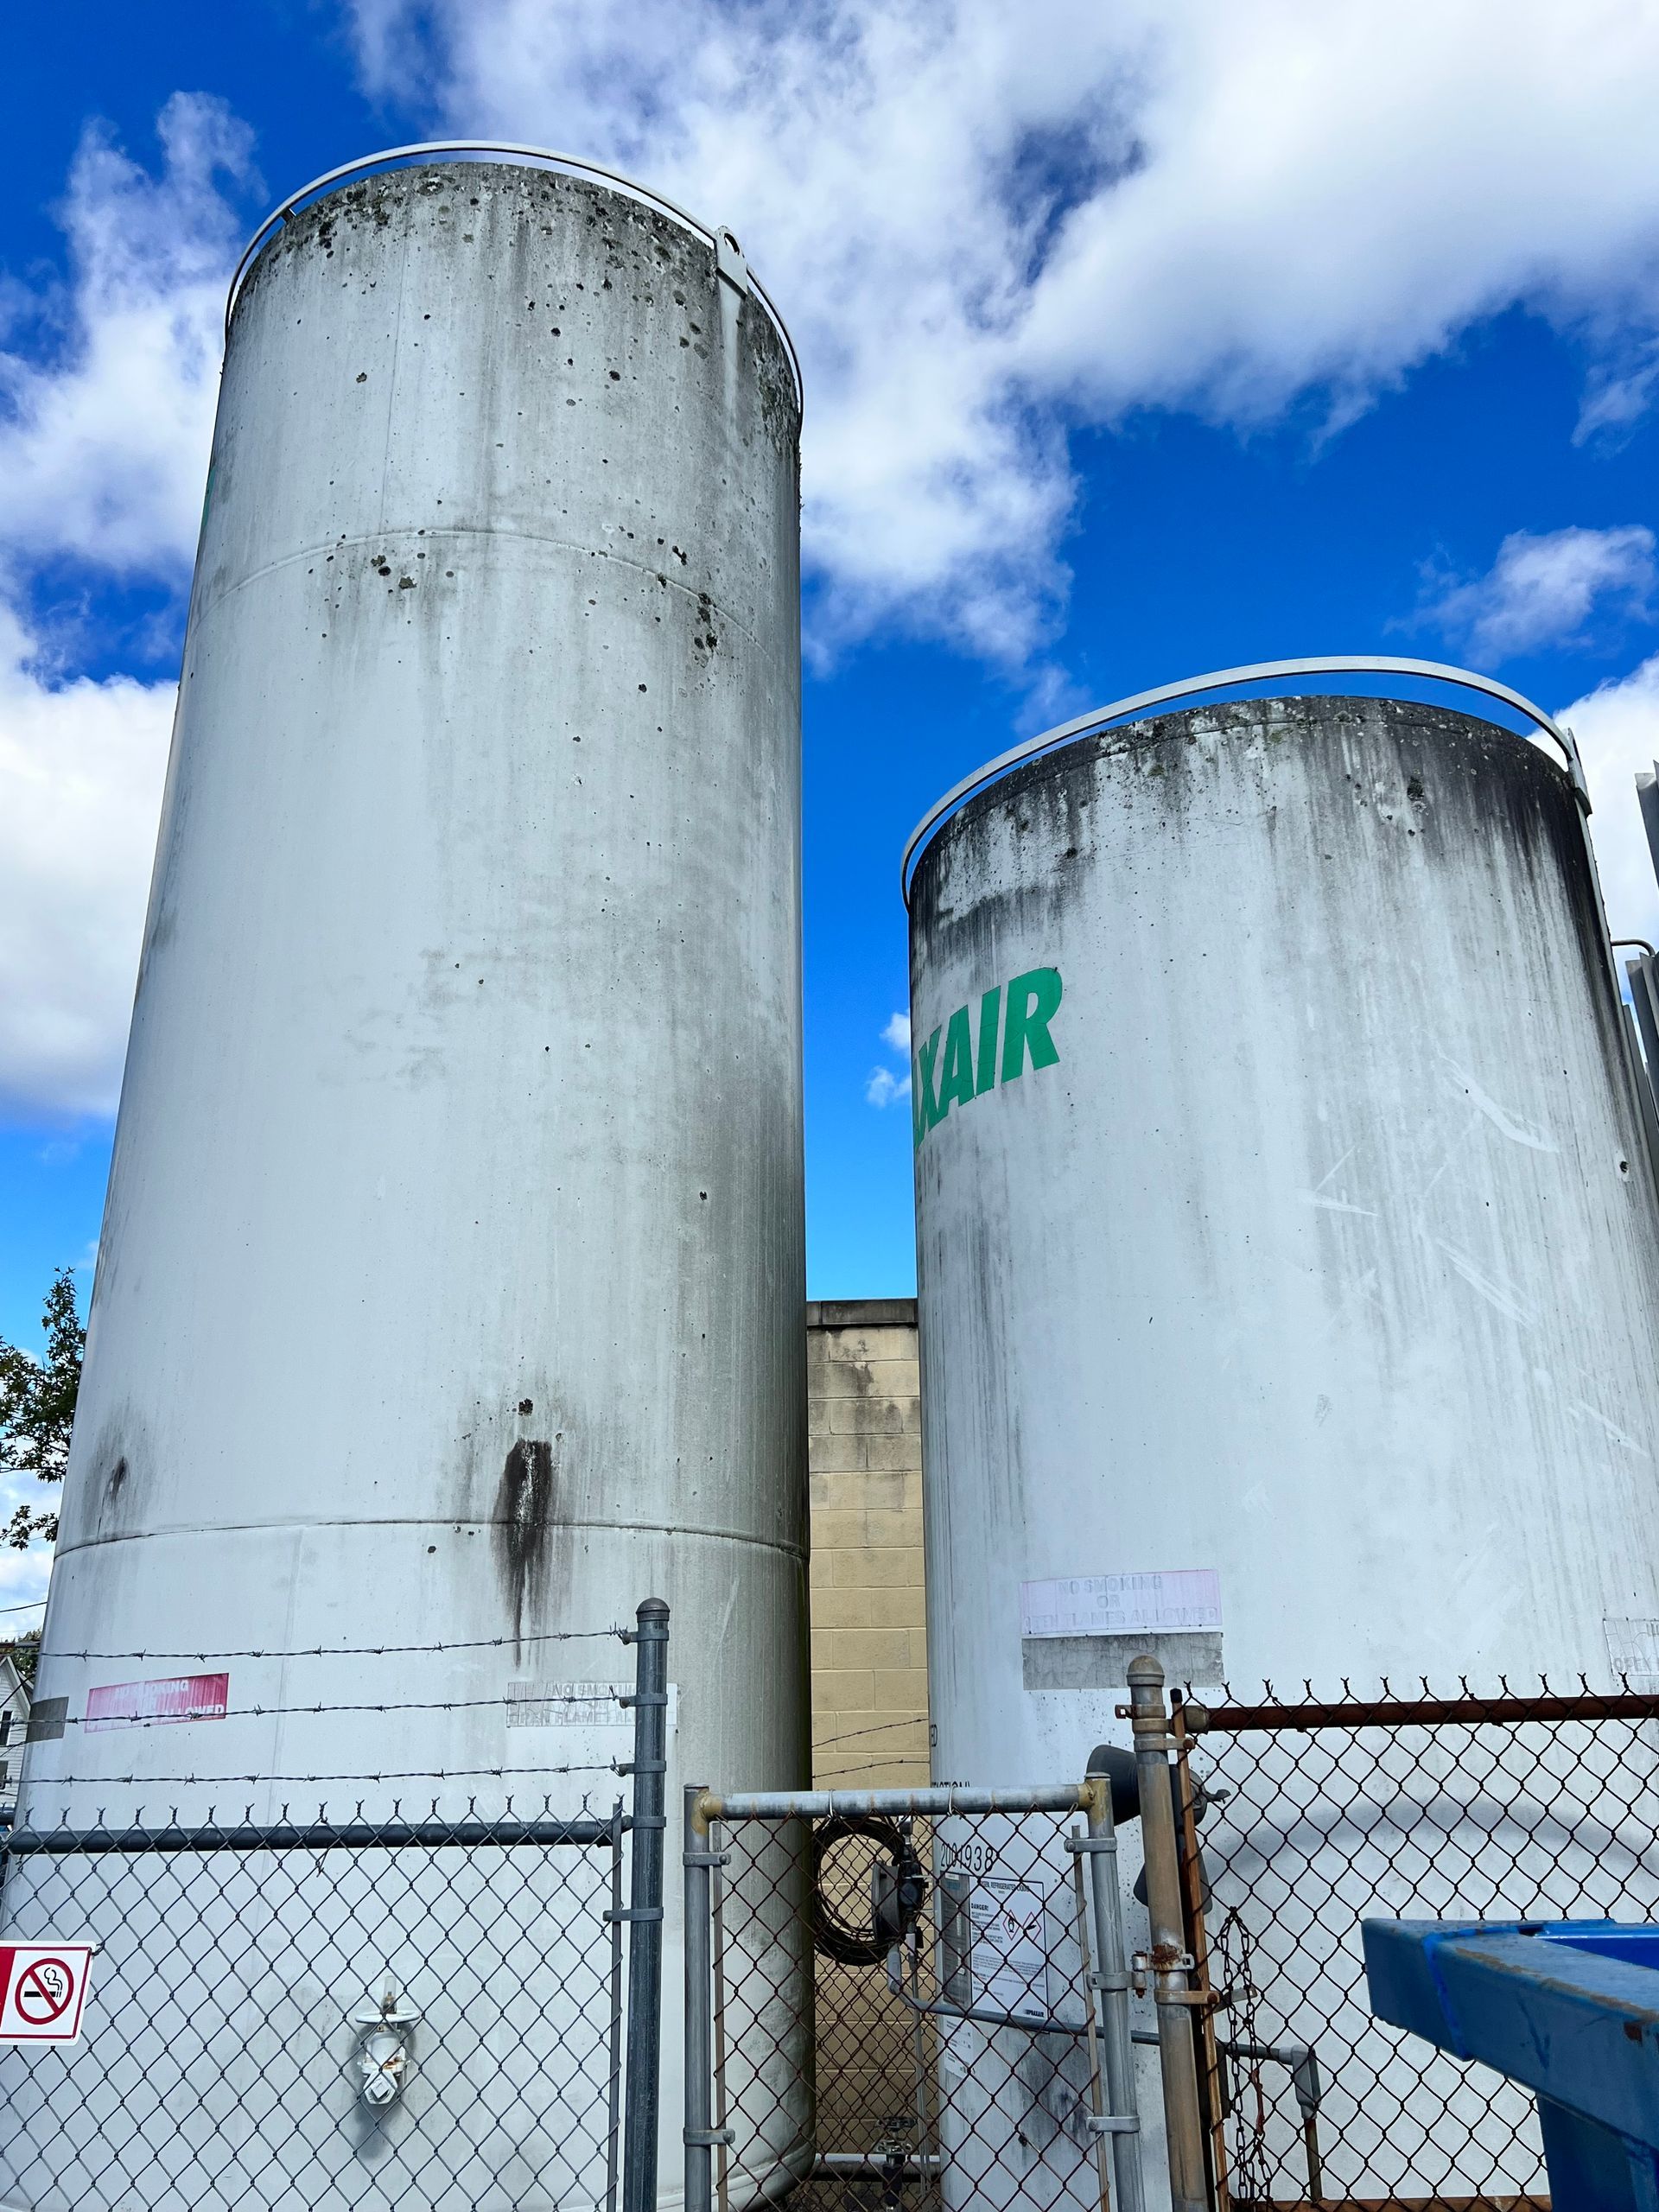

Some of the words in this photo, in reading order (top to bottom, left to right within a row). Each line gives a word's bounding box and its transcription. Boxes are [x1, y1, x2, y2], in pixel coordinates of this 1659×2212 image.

[1058, 1580, 1080, 1595] NO
[1084, 1574, 1162, 1593] SMOKING
[1096, 1594, 1121, 1609] OR
